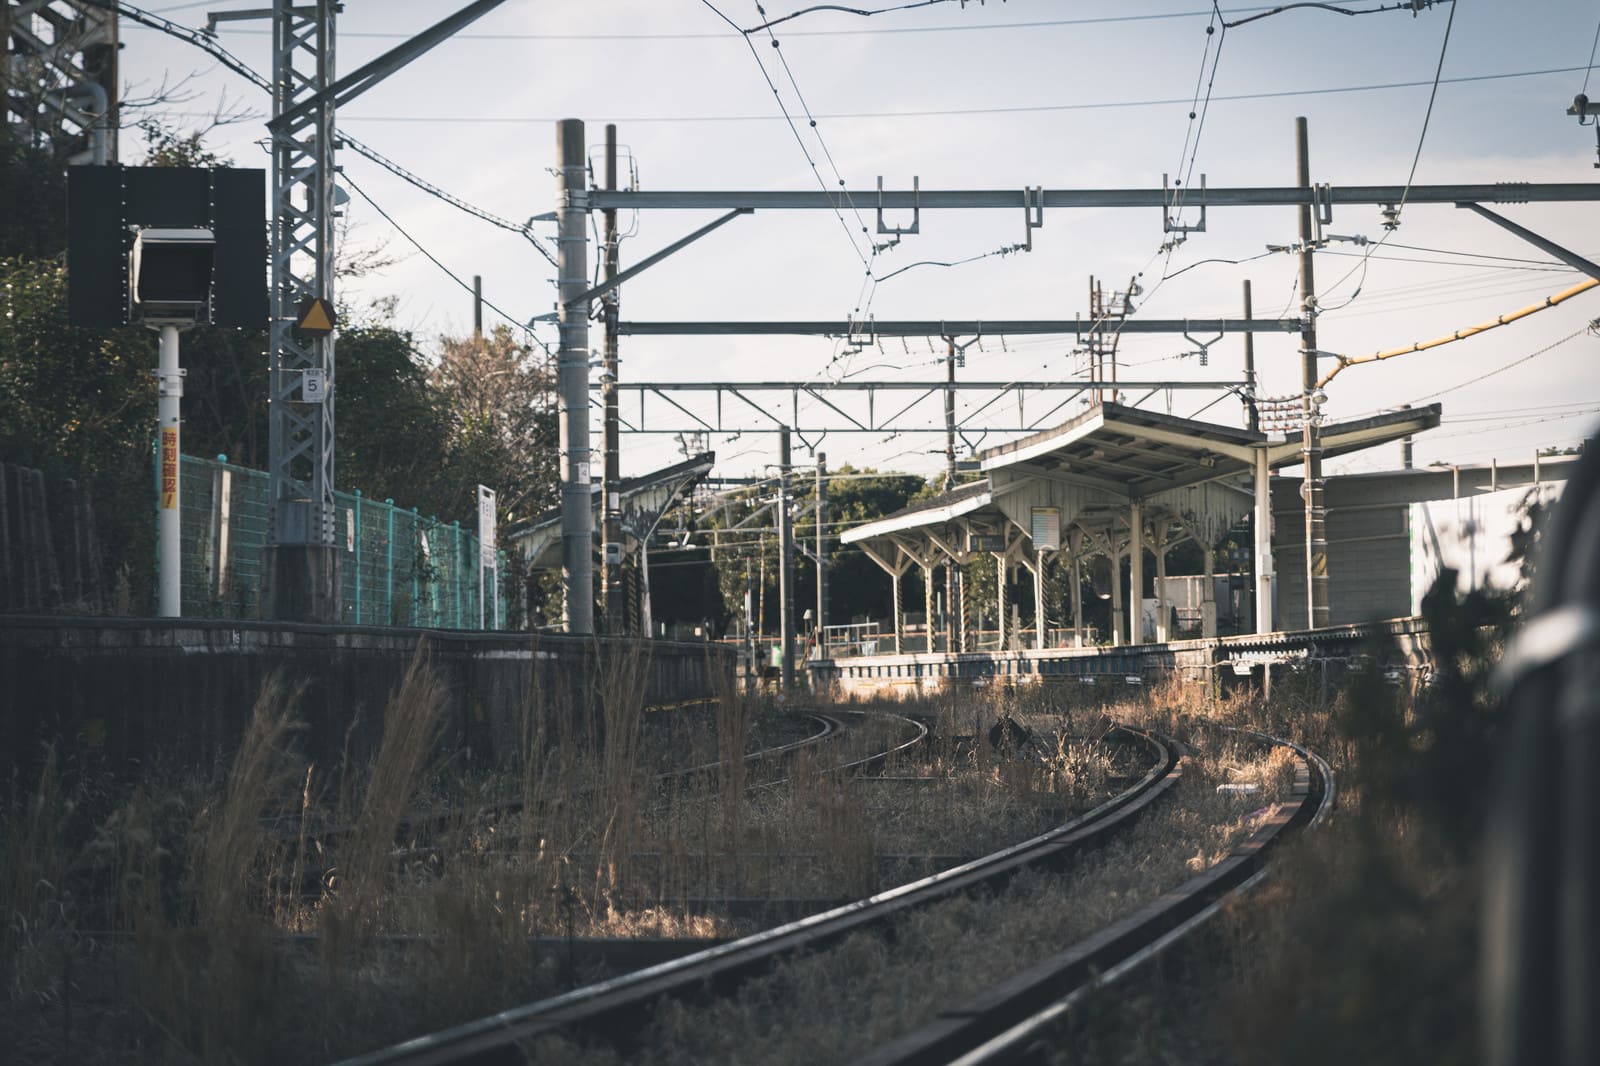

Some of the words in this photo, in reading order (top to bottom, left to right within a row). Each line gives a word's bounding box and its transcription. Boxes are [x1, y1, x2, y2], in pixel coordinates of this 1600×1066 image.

[308, 379, 317, 391] 5
[162, 431, 177, 509] 時刻確認!
